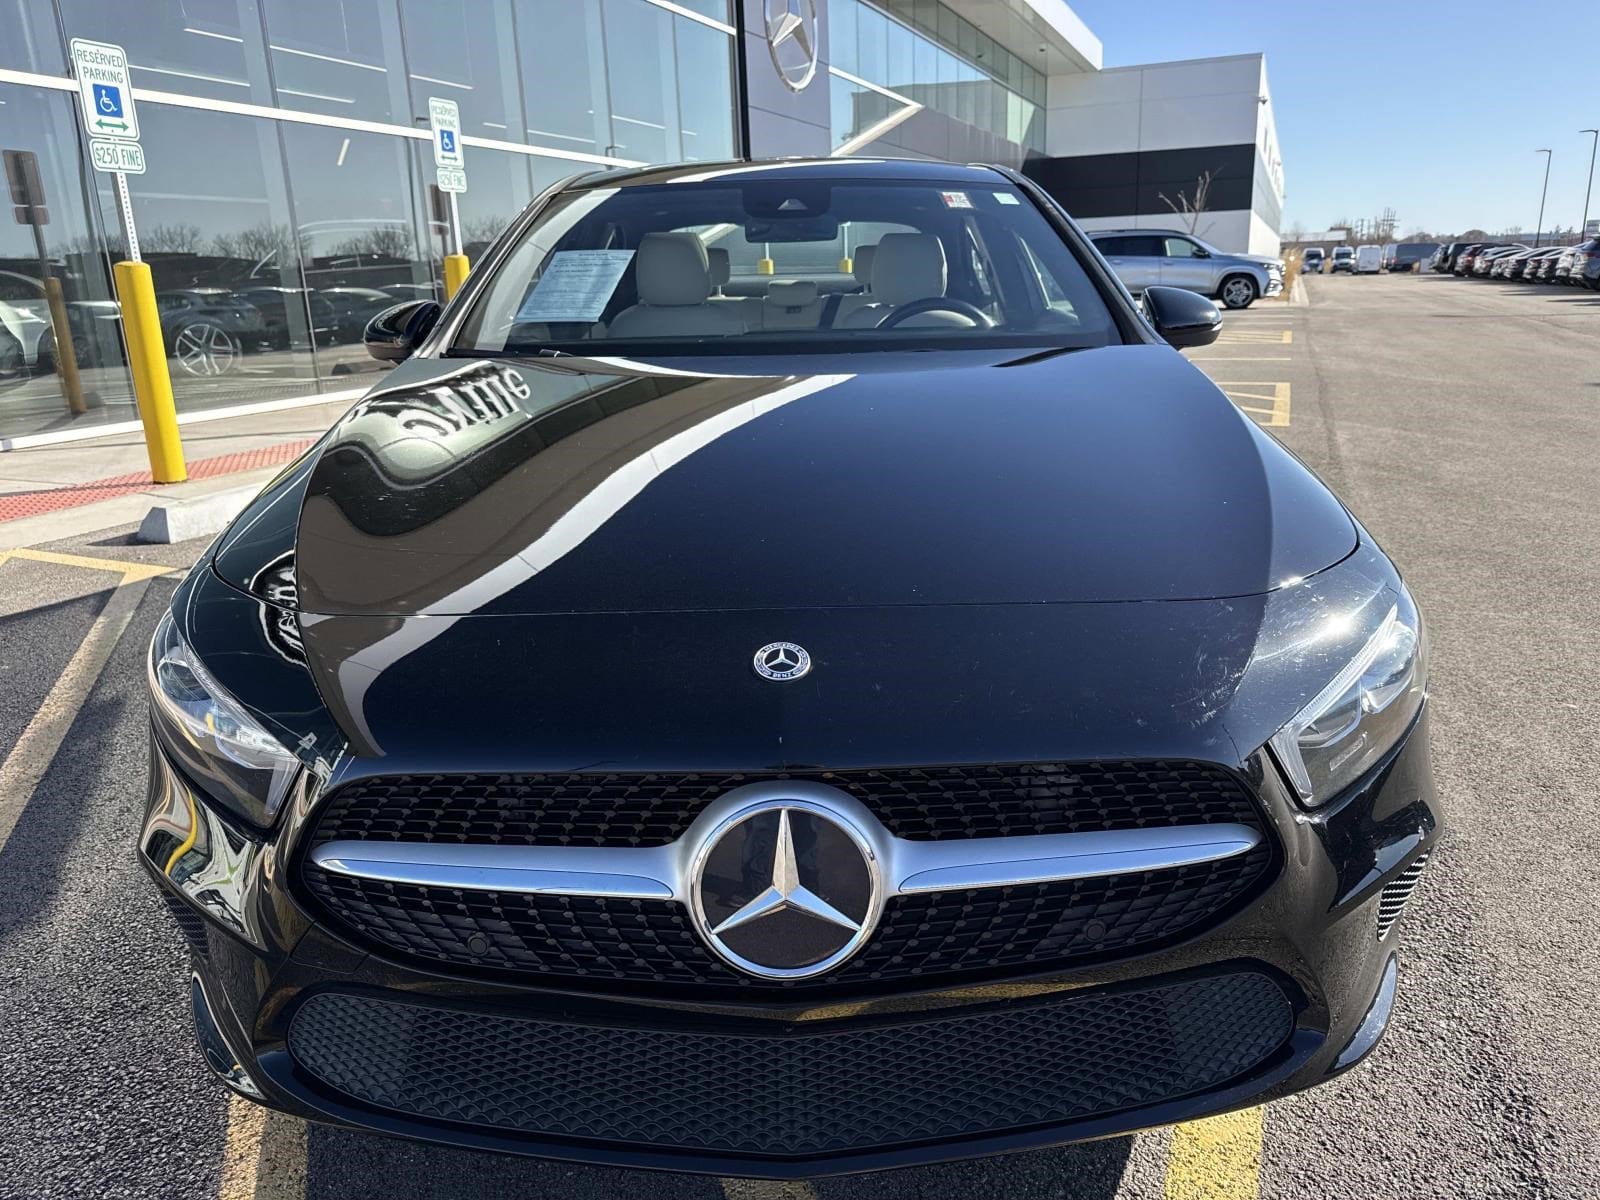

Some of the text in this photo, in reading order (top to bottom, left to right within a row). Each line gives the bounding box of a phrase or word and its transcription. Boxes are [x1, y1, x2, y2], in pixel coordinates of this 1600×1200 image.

[76, 49, 123, 68] RESERVED
[83, 66, 124, 83] PARKING
[95, 146, 141, 166] $250 FINE
